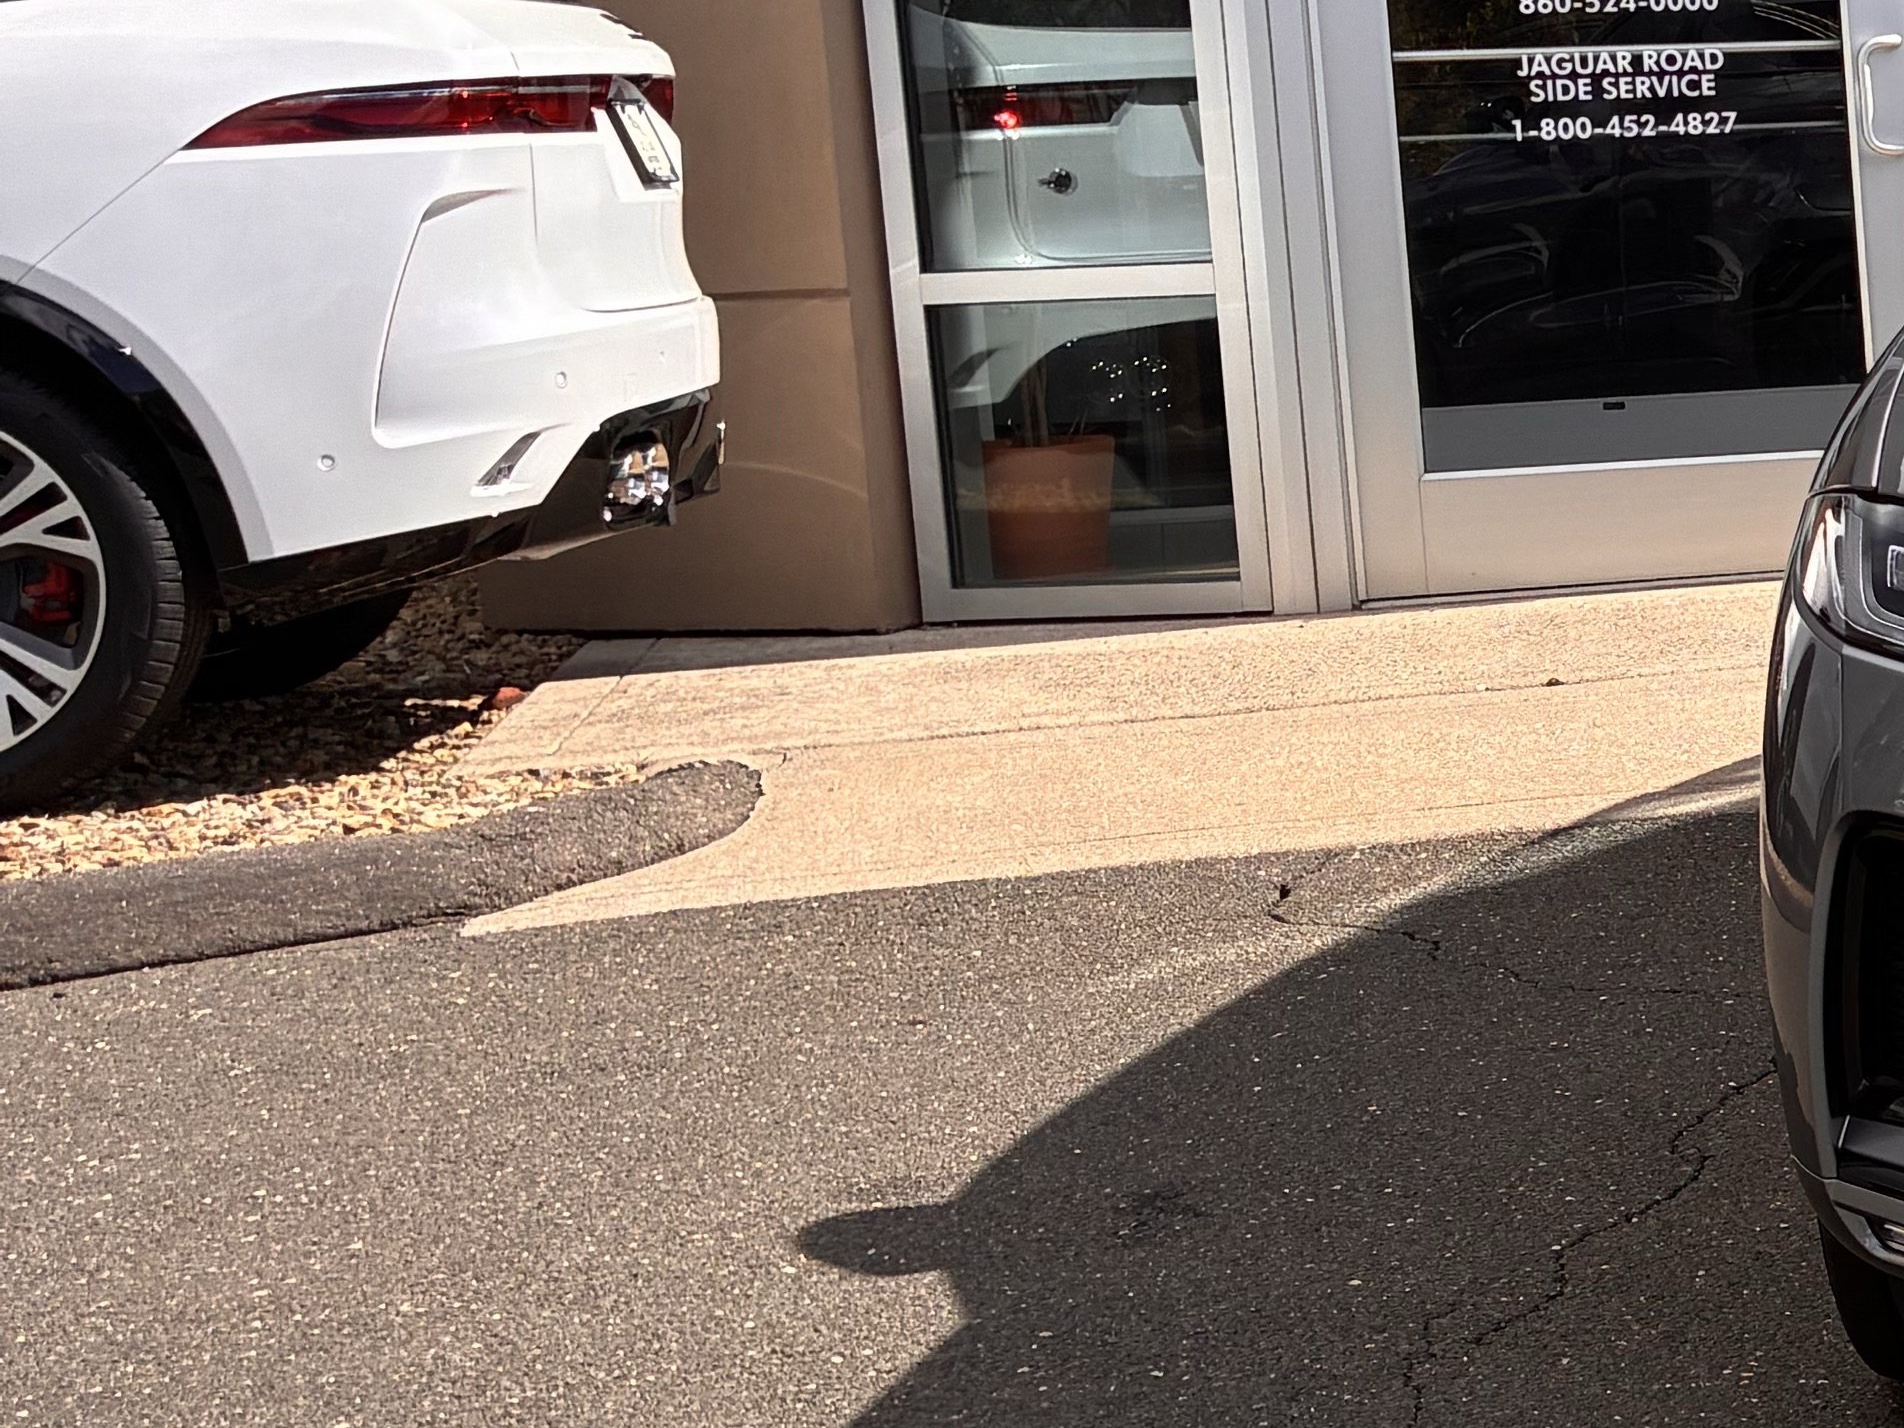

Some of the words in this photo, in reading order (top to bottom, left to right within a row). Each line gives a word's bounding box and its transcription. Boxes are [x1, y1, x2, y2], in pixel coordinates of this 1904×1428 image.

[1516, 51, 1634, 77] JAGUAR
[1642, 49, 1725, 73] ROAD
[1529, 78, 1593, 103] SIDE
[1601, 74, 1717, 100] SERVICE
[1511, 111, 1738, 142] 1-800-452-4827
